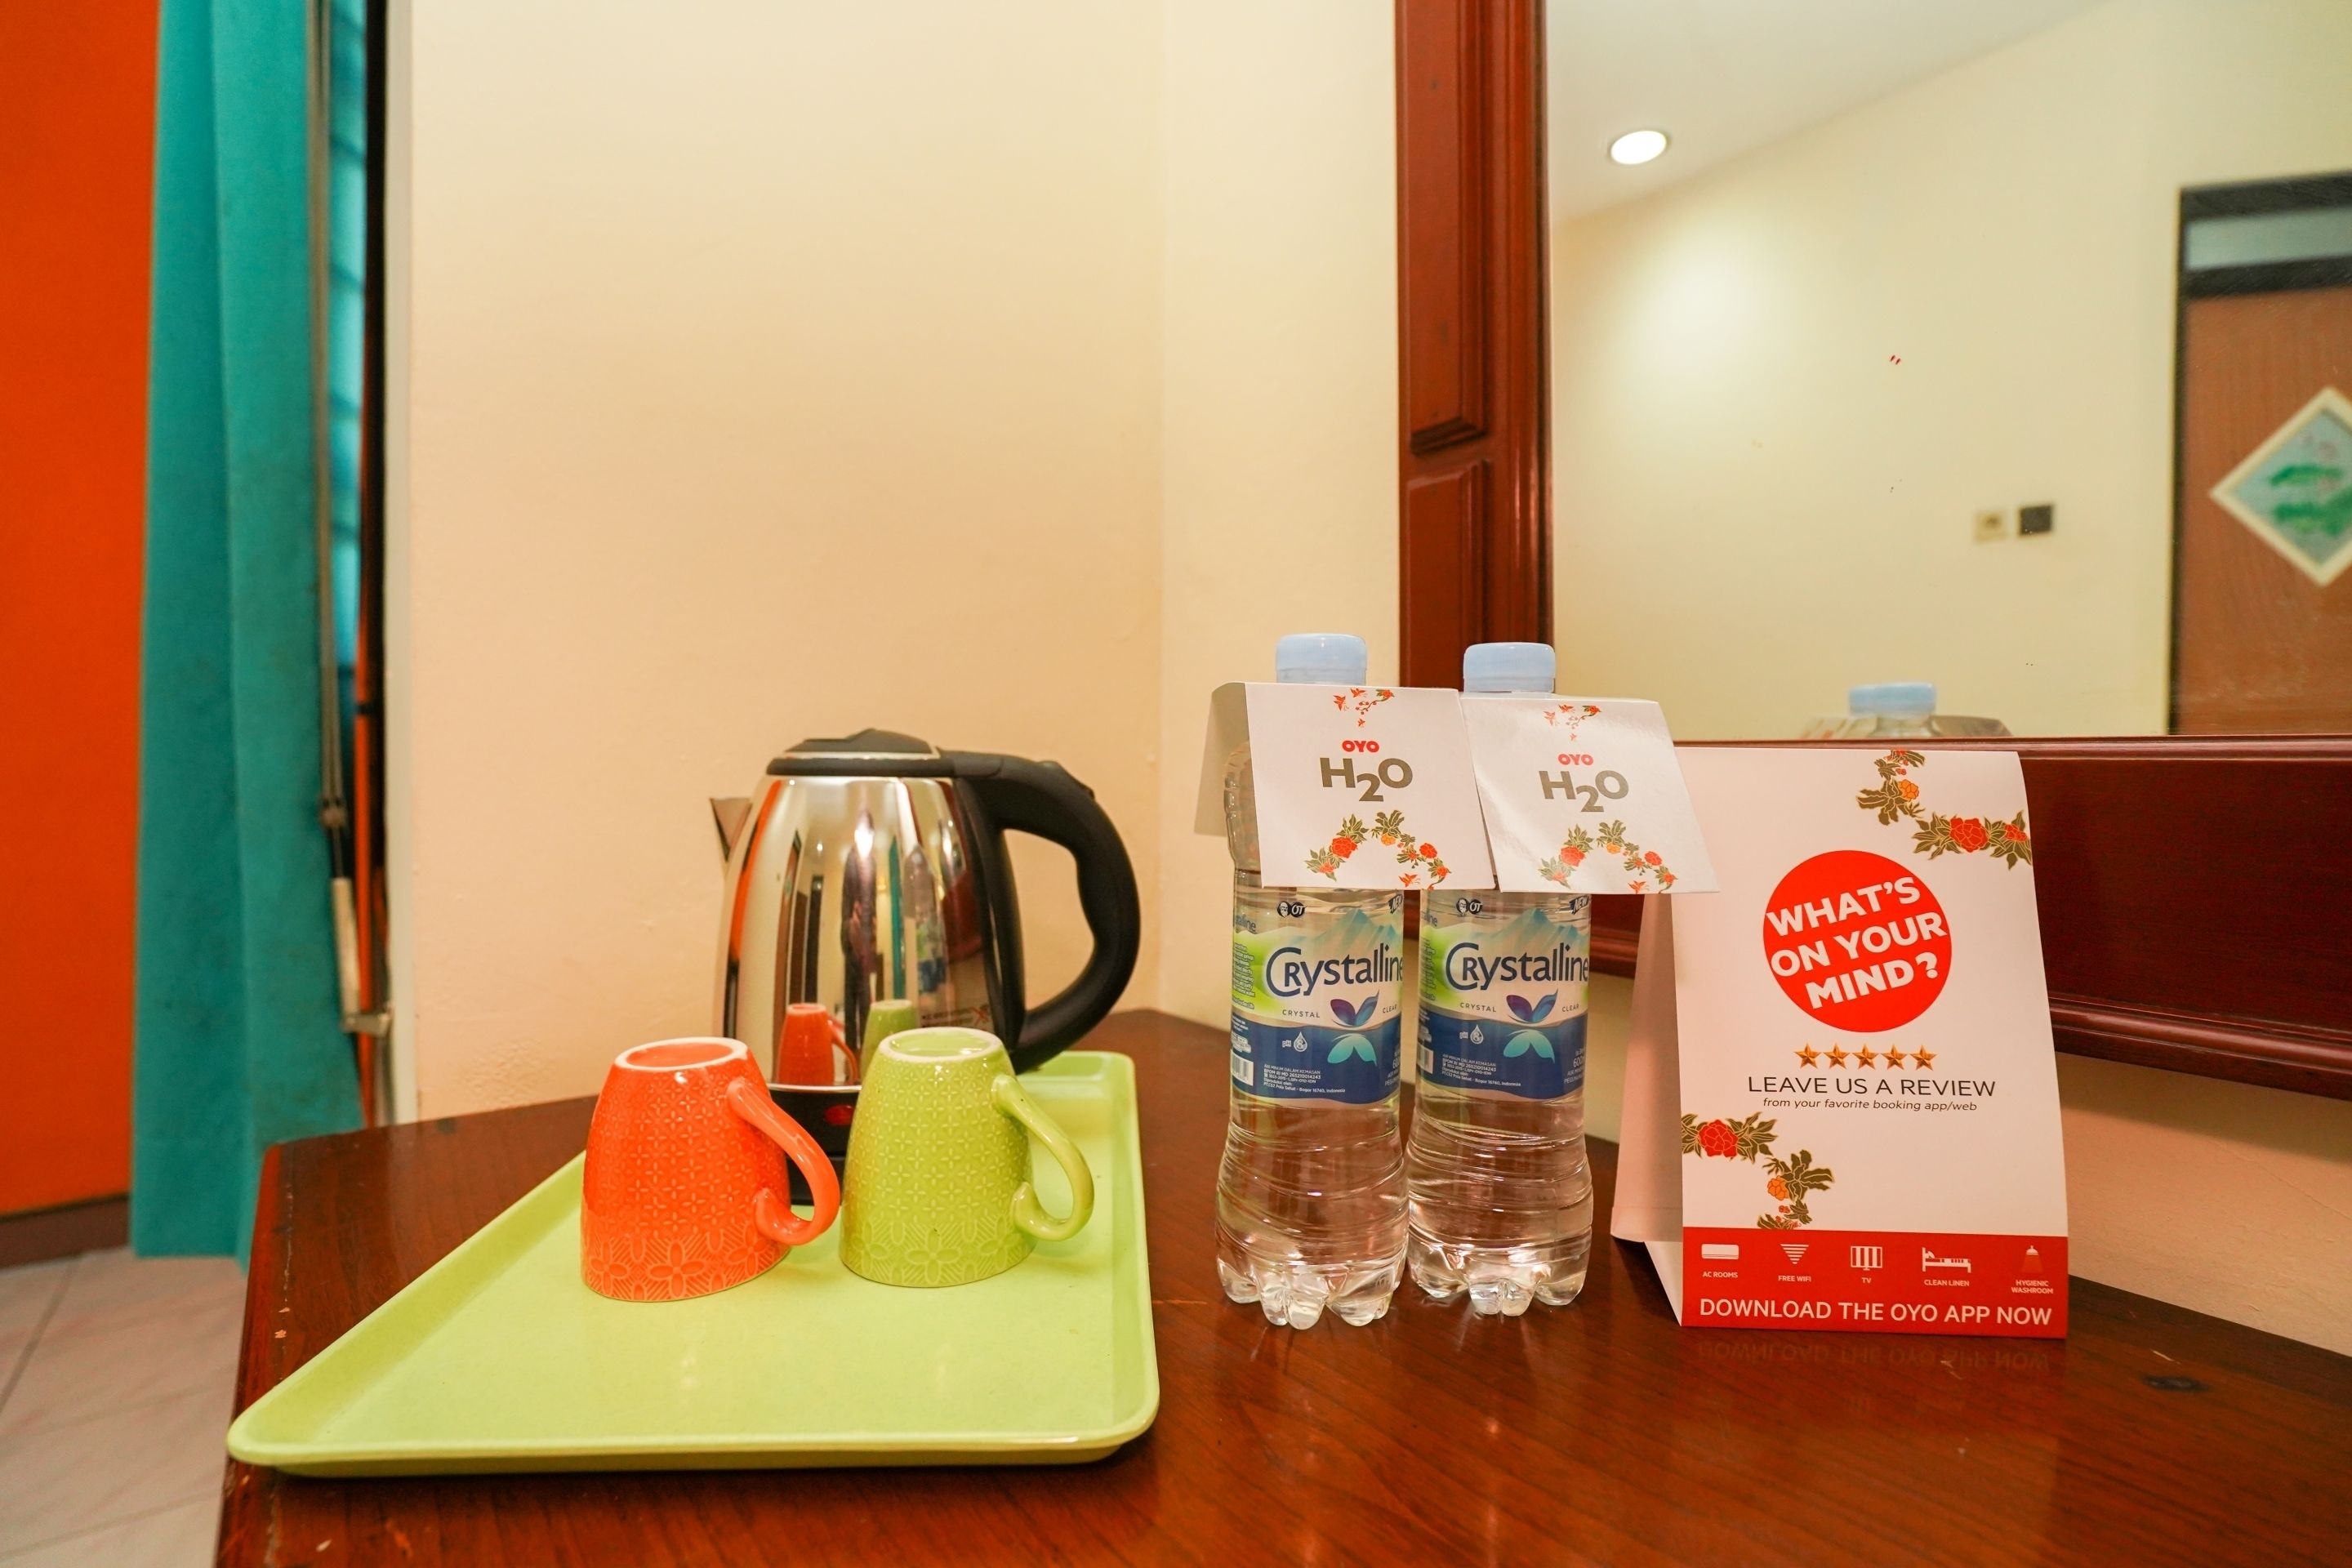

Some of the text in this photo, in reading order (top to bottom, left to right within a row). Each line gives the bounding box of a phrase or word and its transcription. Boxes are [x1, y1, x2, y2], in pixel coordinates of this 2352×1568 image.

[1342, 740, 1380, 753] OYO
[1557, 753, 1593, 765] OYO
[1320, 757, 1414, 802] H2O
[1539, 770, 1629, 813] H2O
[1291, 904, 1306, 915] OT
[1766, 876, 1921, 937] WHAT’S
[1771, 911, 1948, 977] ON YOUR
[1805, 951, 1939, 1009] MIND?
[1282, 1009, 1321, 1018] CRYSTAL
[1459, 1002, 1579, 1013] CRYSTAL CLEAR
[1748, 1076, 1996, 1098] LEAVE US A REVIEW
[1762, 1098, 1977, 1112] from your favorite booking app/web
[1713, 1271, 1739, 1279] ROOMS
[2011, 1286, 2054, 1294] WASHROOM
[1699, 1298, 2052, 1325] DOWNLOAD THE OYO APP NOW
